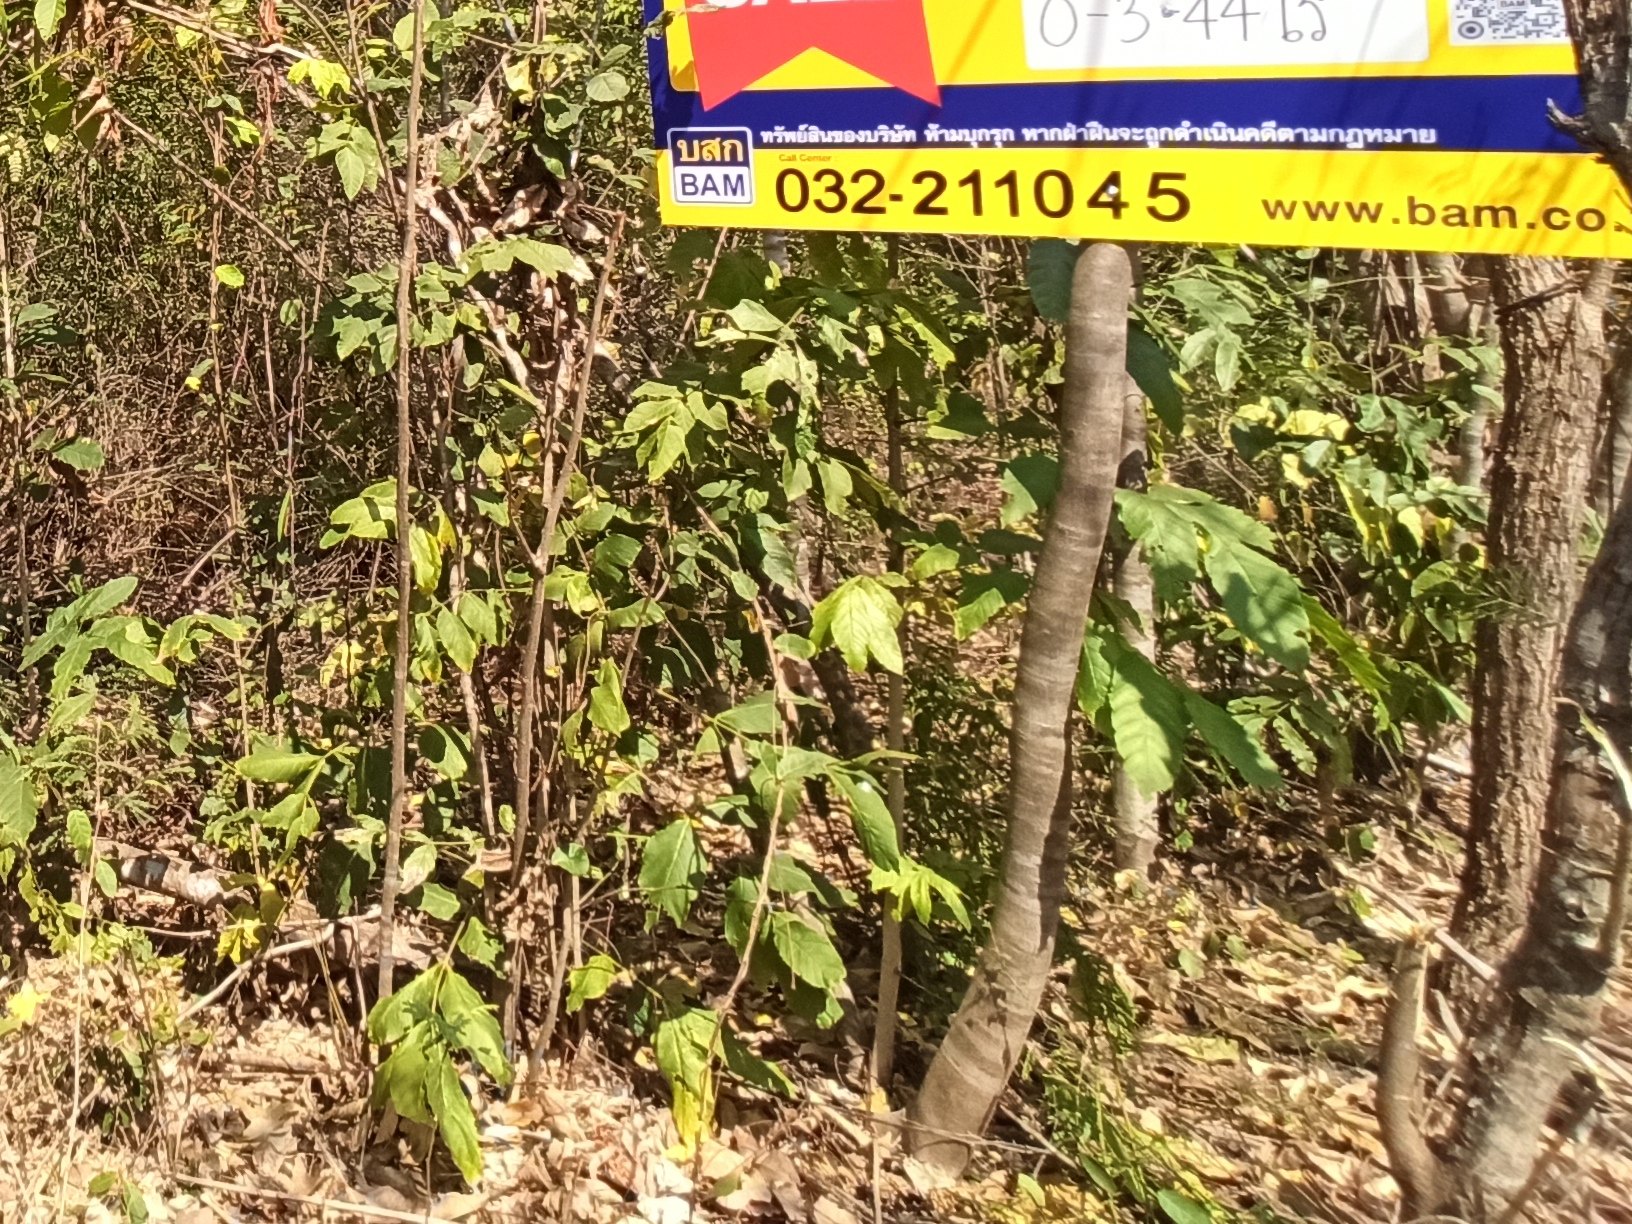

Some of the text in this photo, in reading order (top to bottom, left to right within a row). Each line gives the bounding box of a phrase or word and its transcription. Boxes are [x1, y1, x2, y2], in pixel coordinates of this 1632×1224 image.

[760, 123, 917, 144] ทรัพย์สินของบริษัท
[924, 123, 1015, 147] ห้ามบุกรุก
[676, 137, 744, 163] บสก
[778, 154, 798, 163] Call
[680, 173, 746, 197] BAM
[774, 167, 1191, 223] 032-211045
